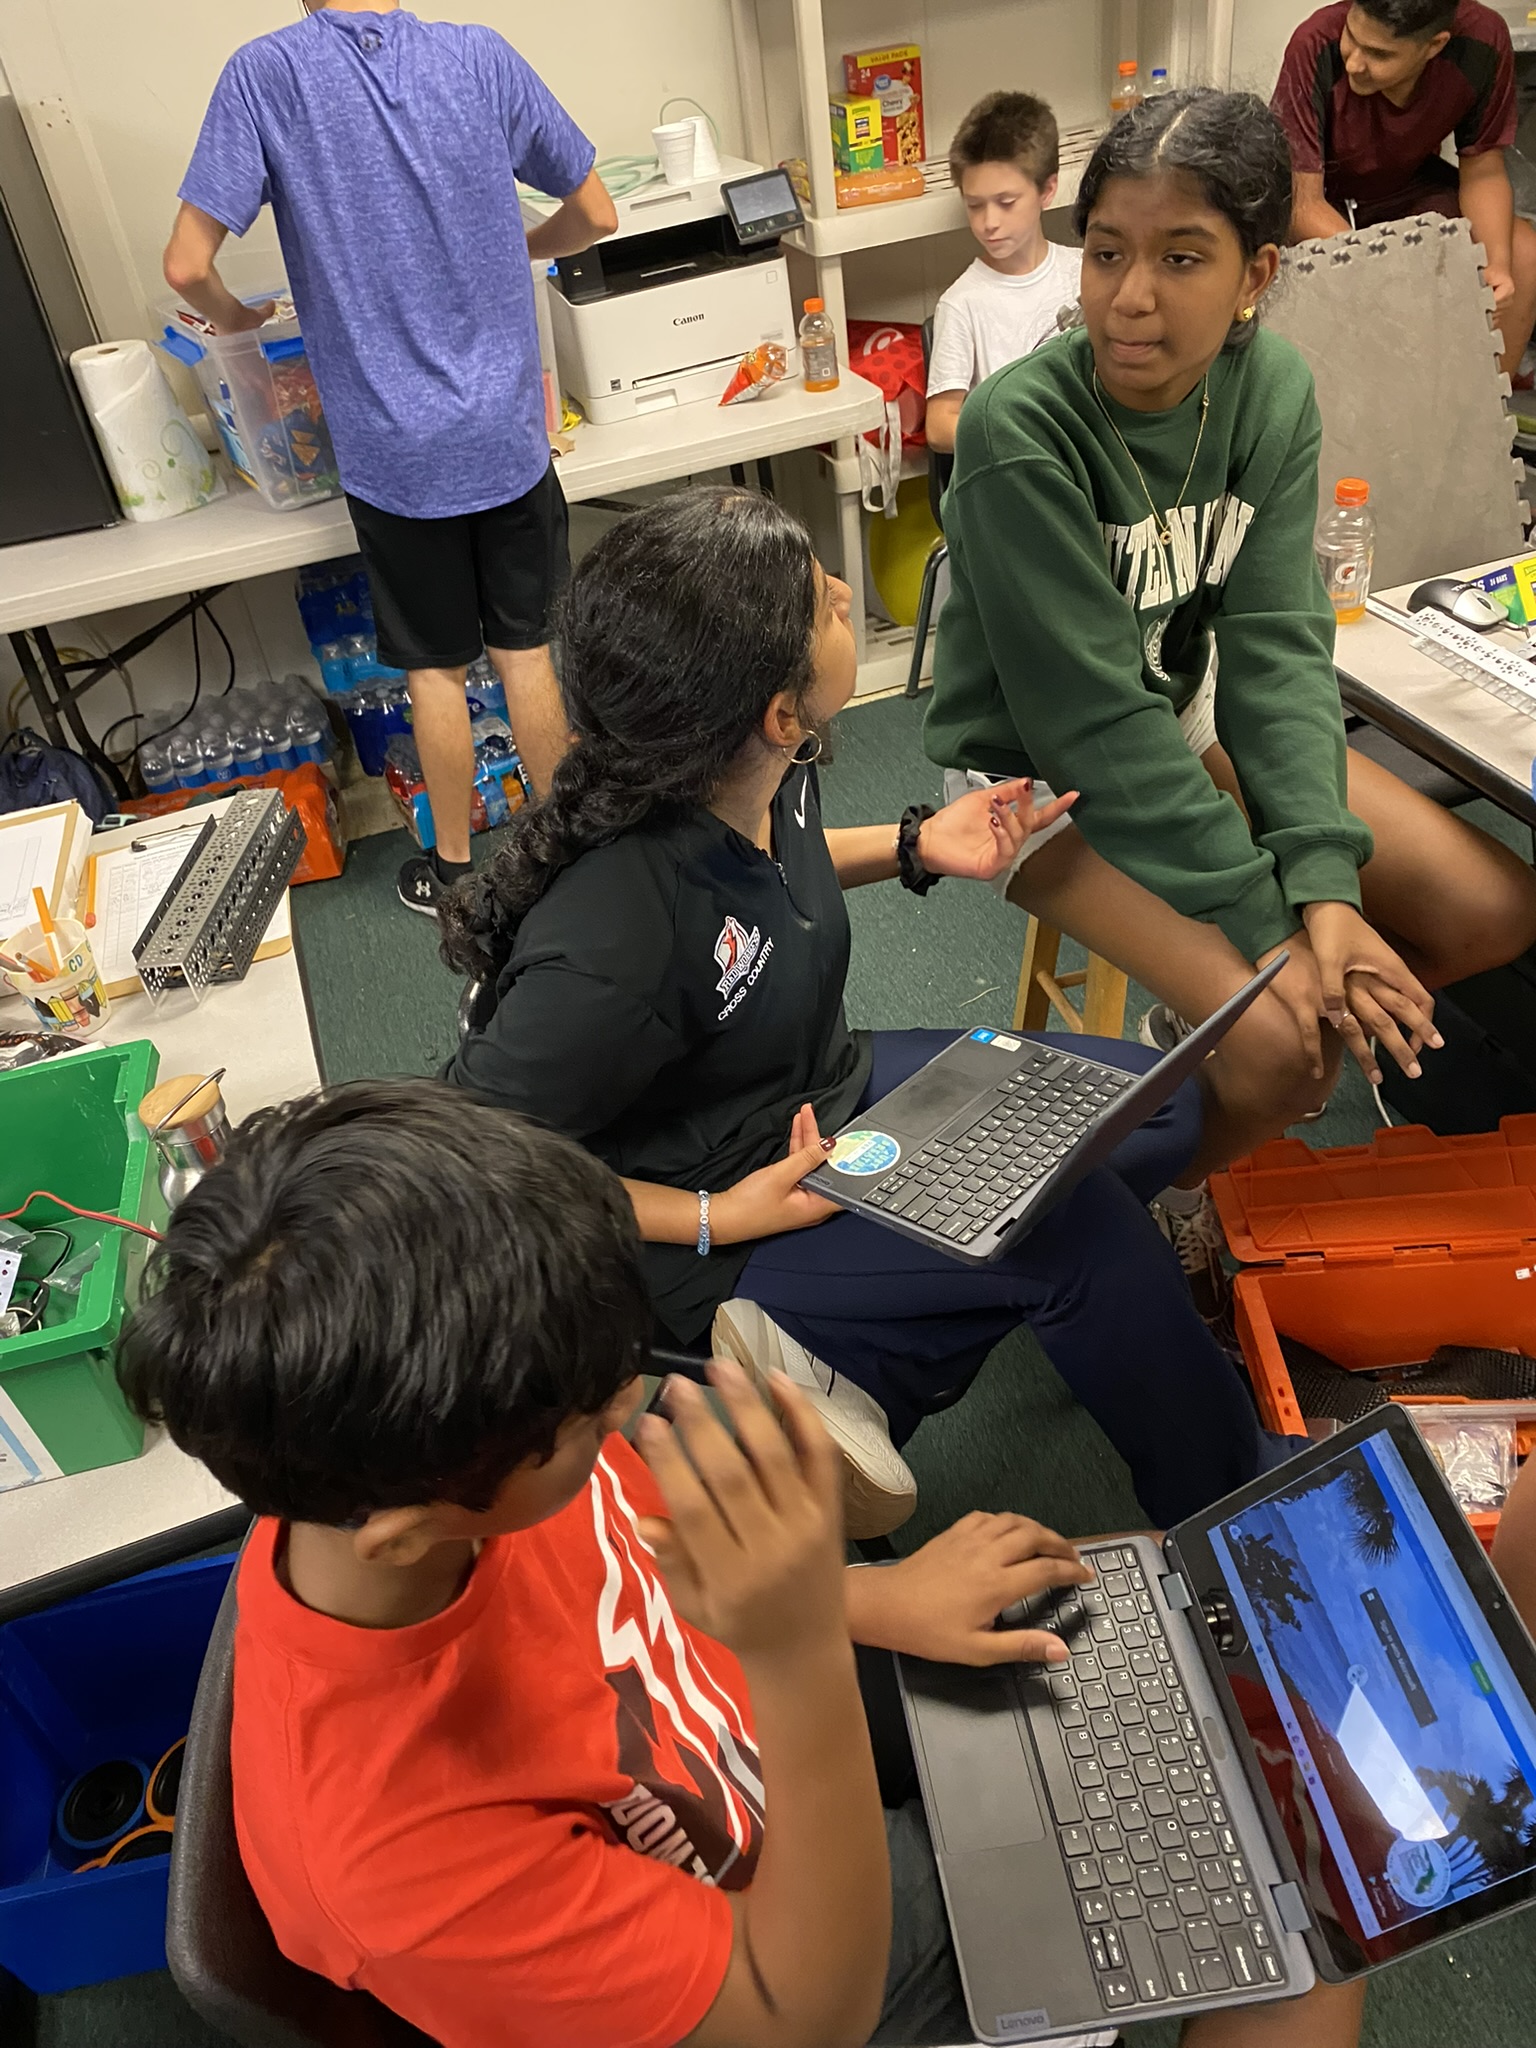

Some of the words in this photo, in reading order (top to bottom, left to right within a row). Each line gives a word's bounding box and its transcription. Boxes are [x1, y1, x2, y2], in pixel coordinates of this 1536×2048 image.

[891, 50, 908, 60] PACK
[860, 68, 871, 79] 24
[672, 312, 706, 327] Canon
[718, 986, 748, 1022] CROSS
[746, 936, 776, 986] COUNTRY
[720, 968, 740, 990] RED
[1396, 1657, 1418, 1692] Microsoft
[1103, 1619, 1111, 1628] W
[1147, 1758, 1156, 1766] U
[1167, 1821, 1176, 1830] O
[1062, 1675, 1071, 1683] C
[1079, 1731, 1087, 1739] B
[1087, 1761, 1096, 1769] N
[1096, 1792, 1106, 1801] M
[1146, 1979, 1155, 1996] Shift
[1086, 1657, 1094, 1665] D
[1103, 1713, 1111, 1721] G
[1111, 1742, 1120, 1750] H
[1130, 1803, 1139, 1811] K
[1177, 1972, 1187, 1990] Enter
[1001, 2014, 1044, 2030] Lenovo
